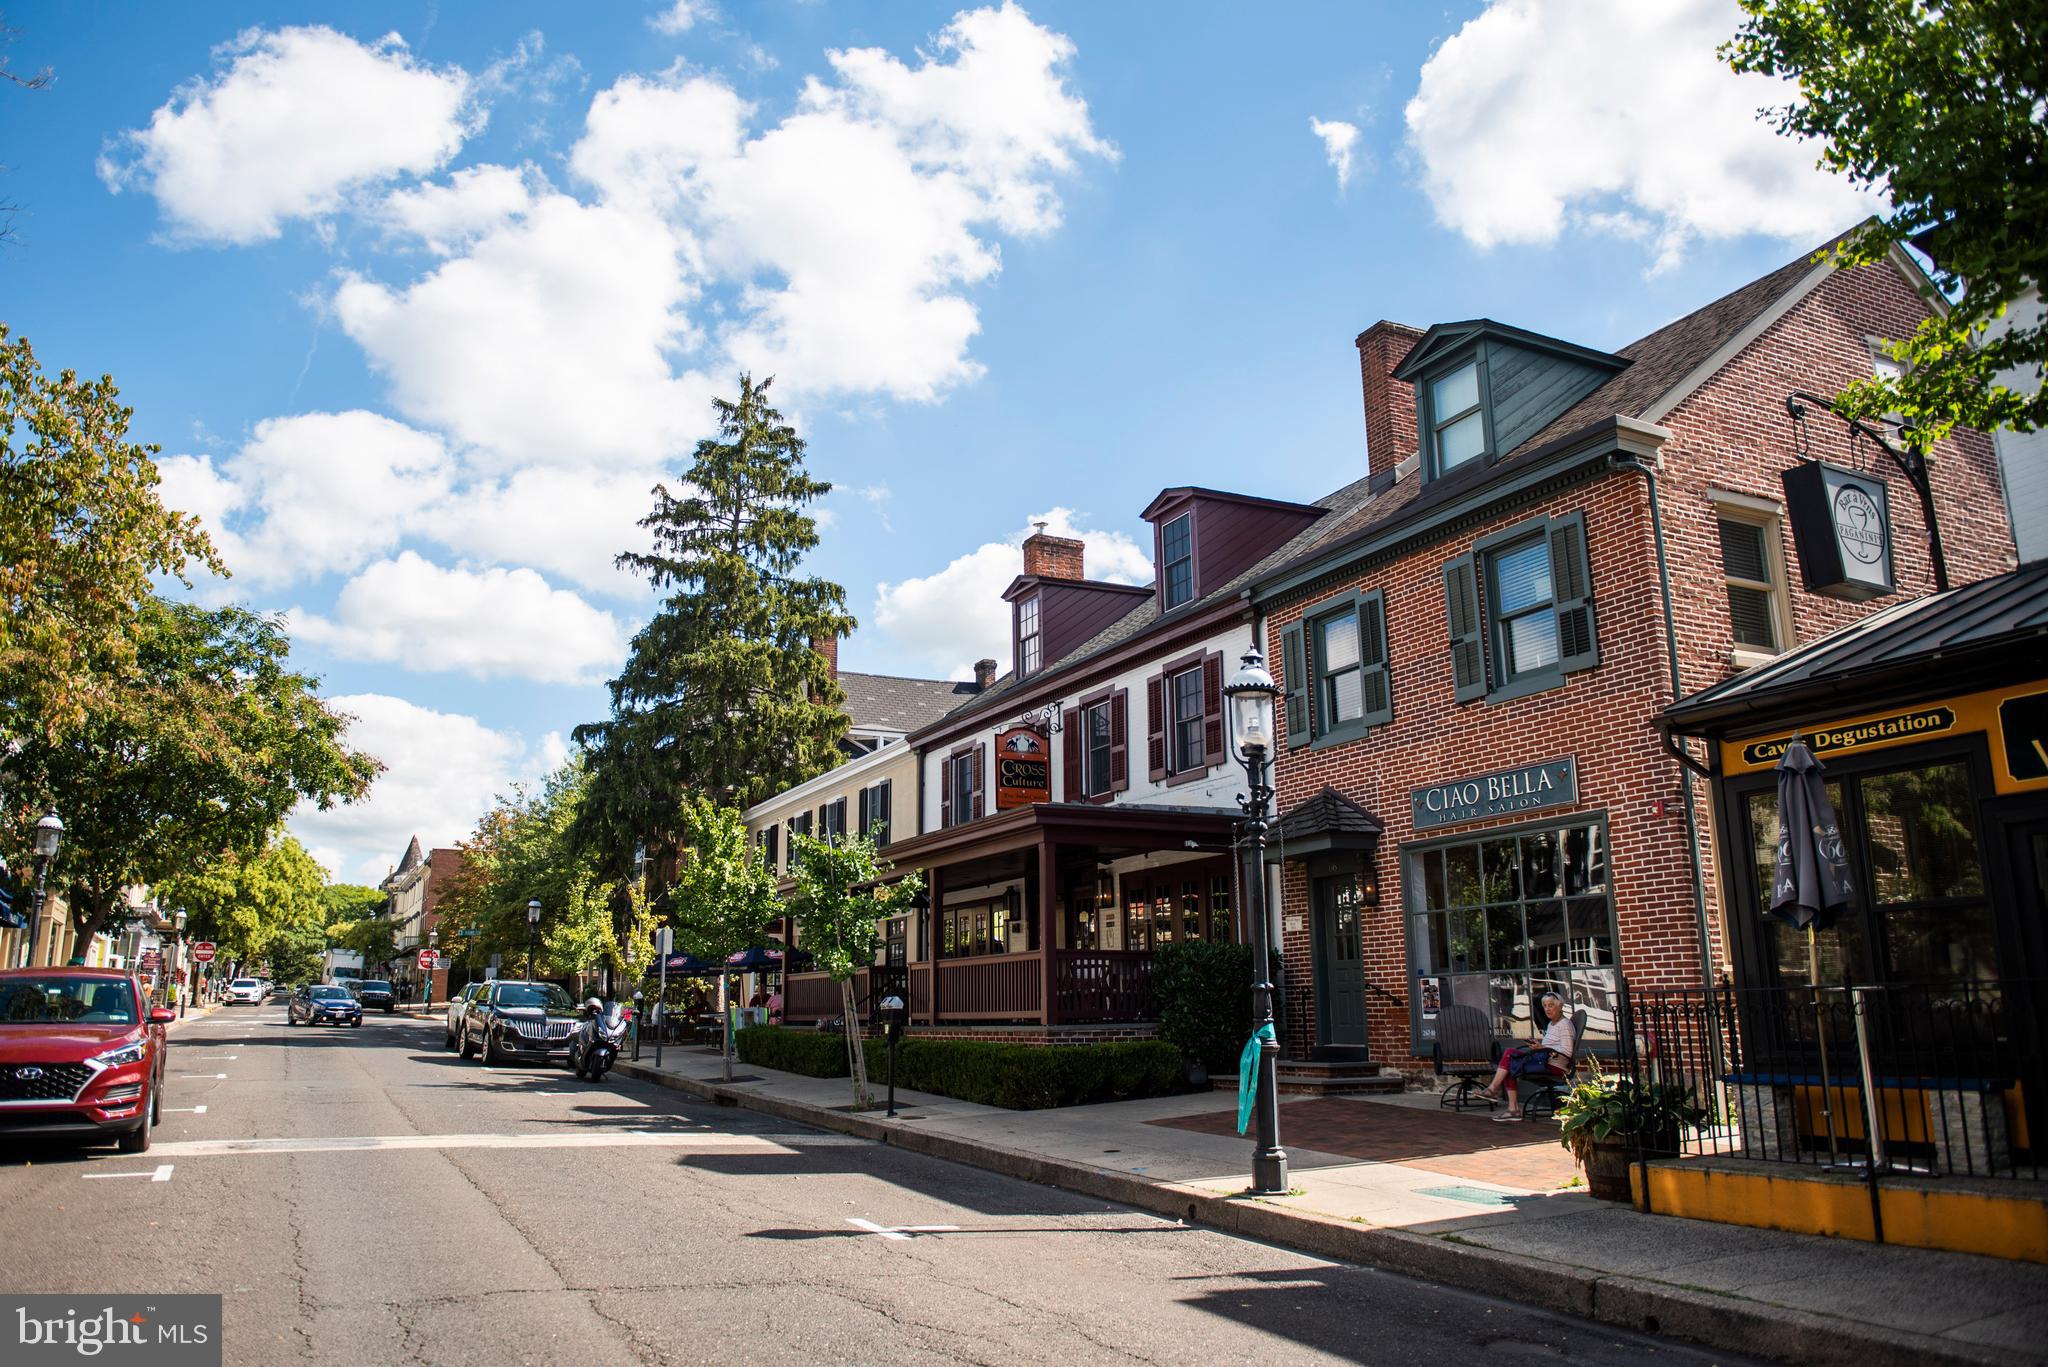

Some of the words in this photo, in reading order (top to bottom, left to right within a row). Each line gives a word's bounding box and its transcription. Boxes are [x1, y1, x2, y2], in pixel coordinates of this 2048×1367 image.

[1754, 740, 1806, 758] Cav
[1815, 714, 1941, 748] Degustation
[1003, 775, 1045, 787] Culture
[1426, 783, 1479, 812] CIAO
[1487, 768, 1553, 801] BELLA
[1439, 808, 1477, 823] HAIR
[1488, 796, 1541, 814] SALON
